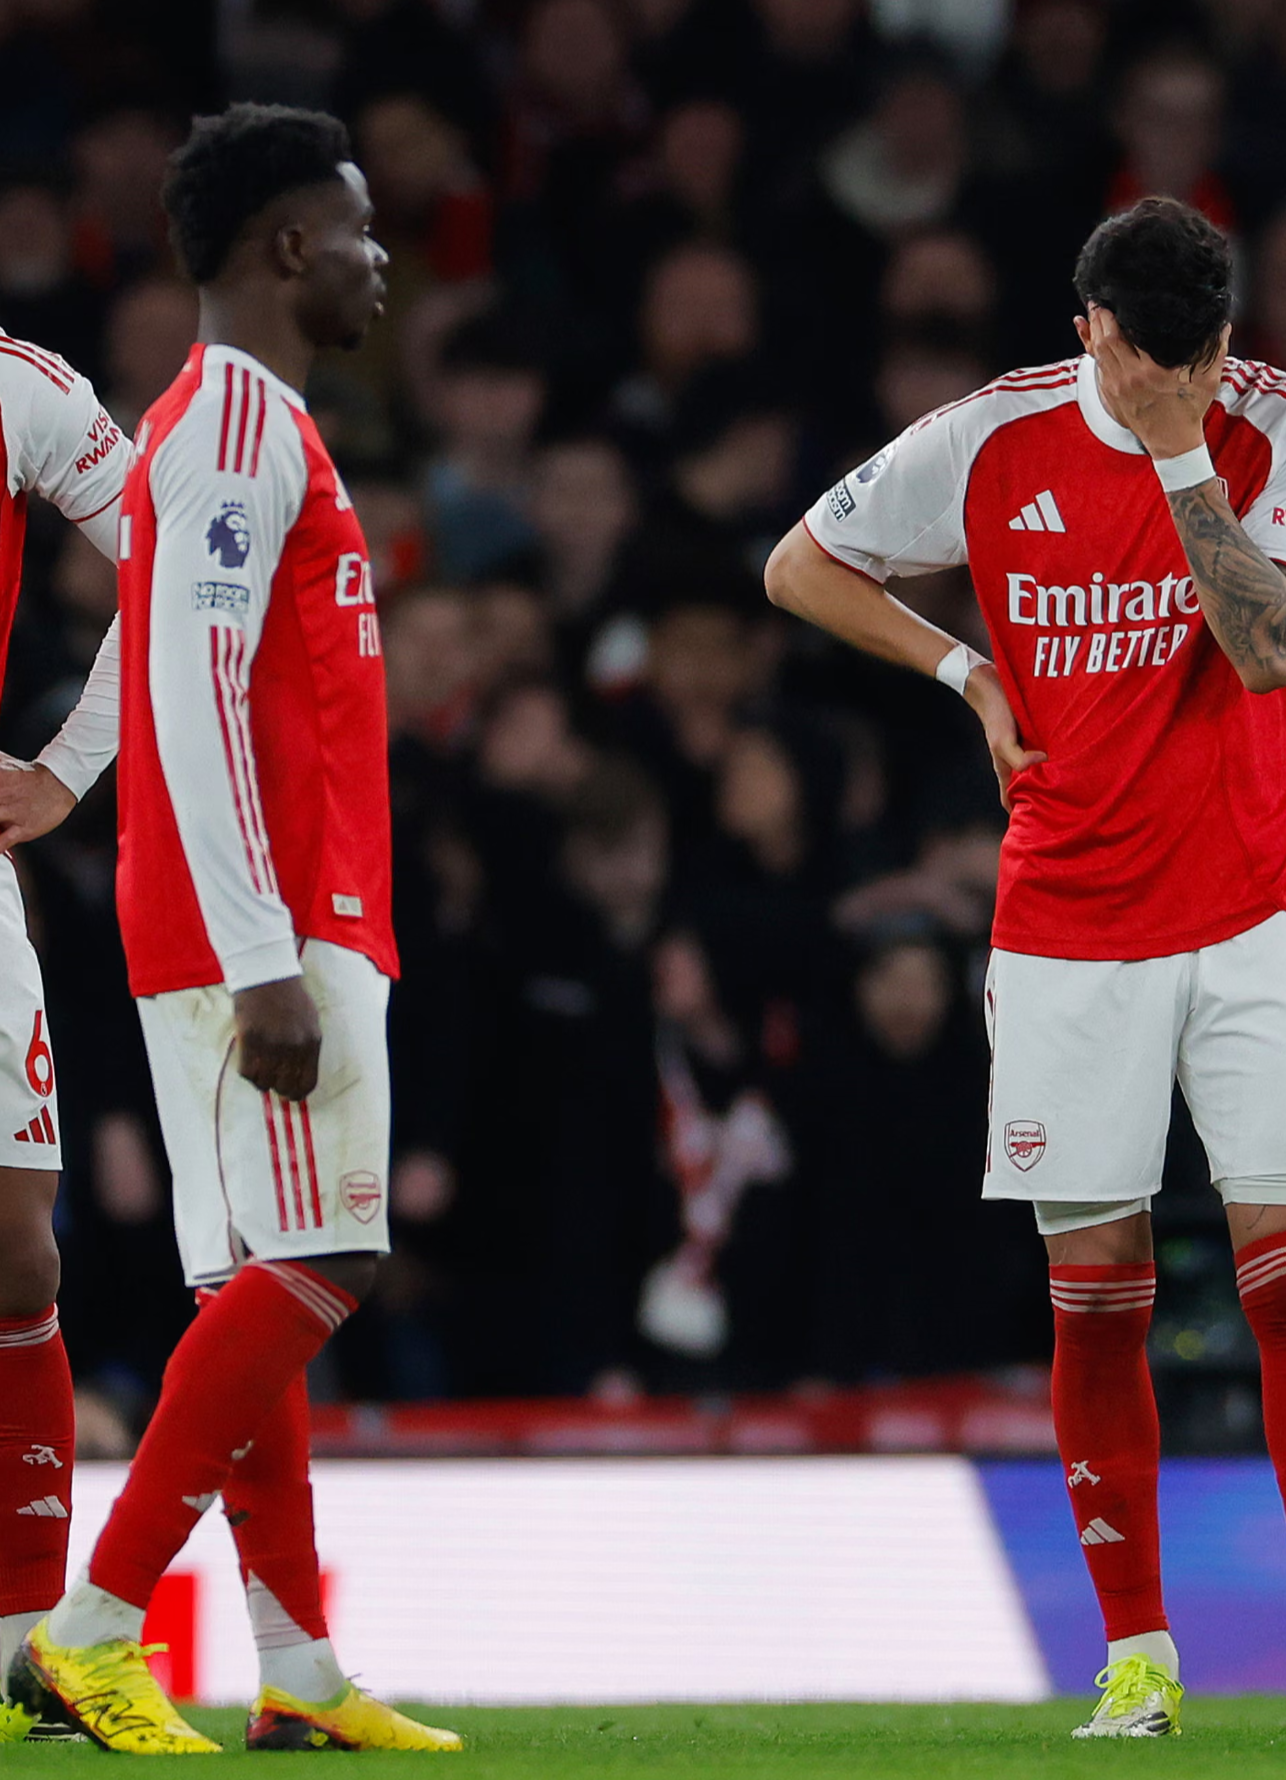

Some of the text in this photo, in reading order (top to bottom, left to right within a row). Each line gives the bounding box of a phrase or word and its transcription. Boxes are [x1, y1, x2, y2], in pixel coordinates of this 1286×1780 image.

[1006, 571, 1200, 627] Emirate
[1034, 635, 1081, 678] FLY
[24, 1009, 54, 1097] 6
[1009, 1129, 1040, 1138] Arsenal
